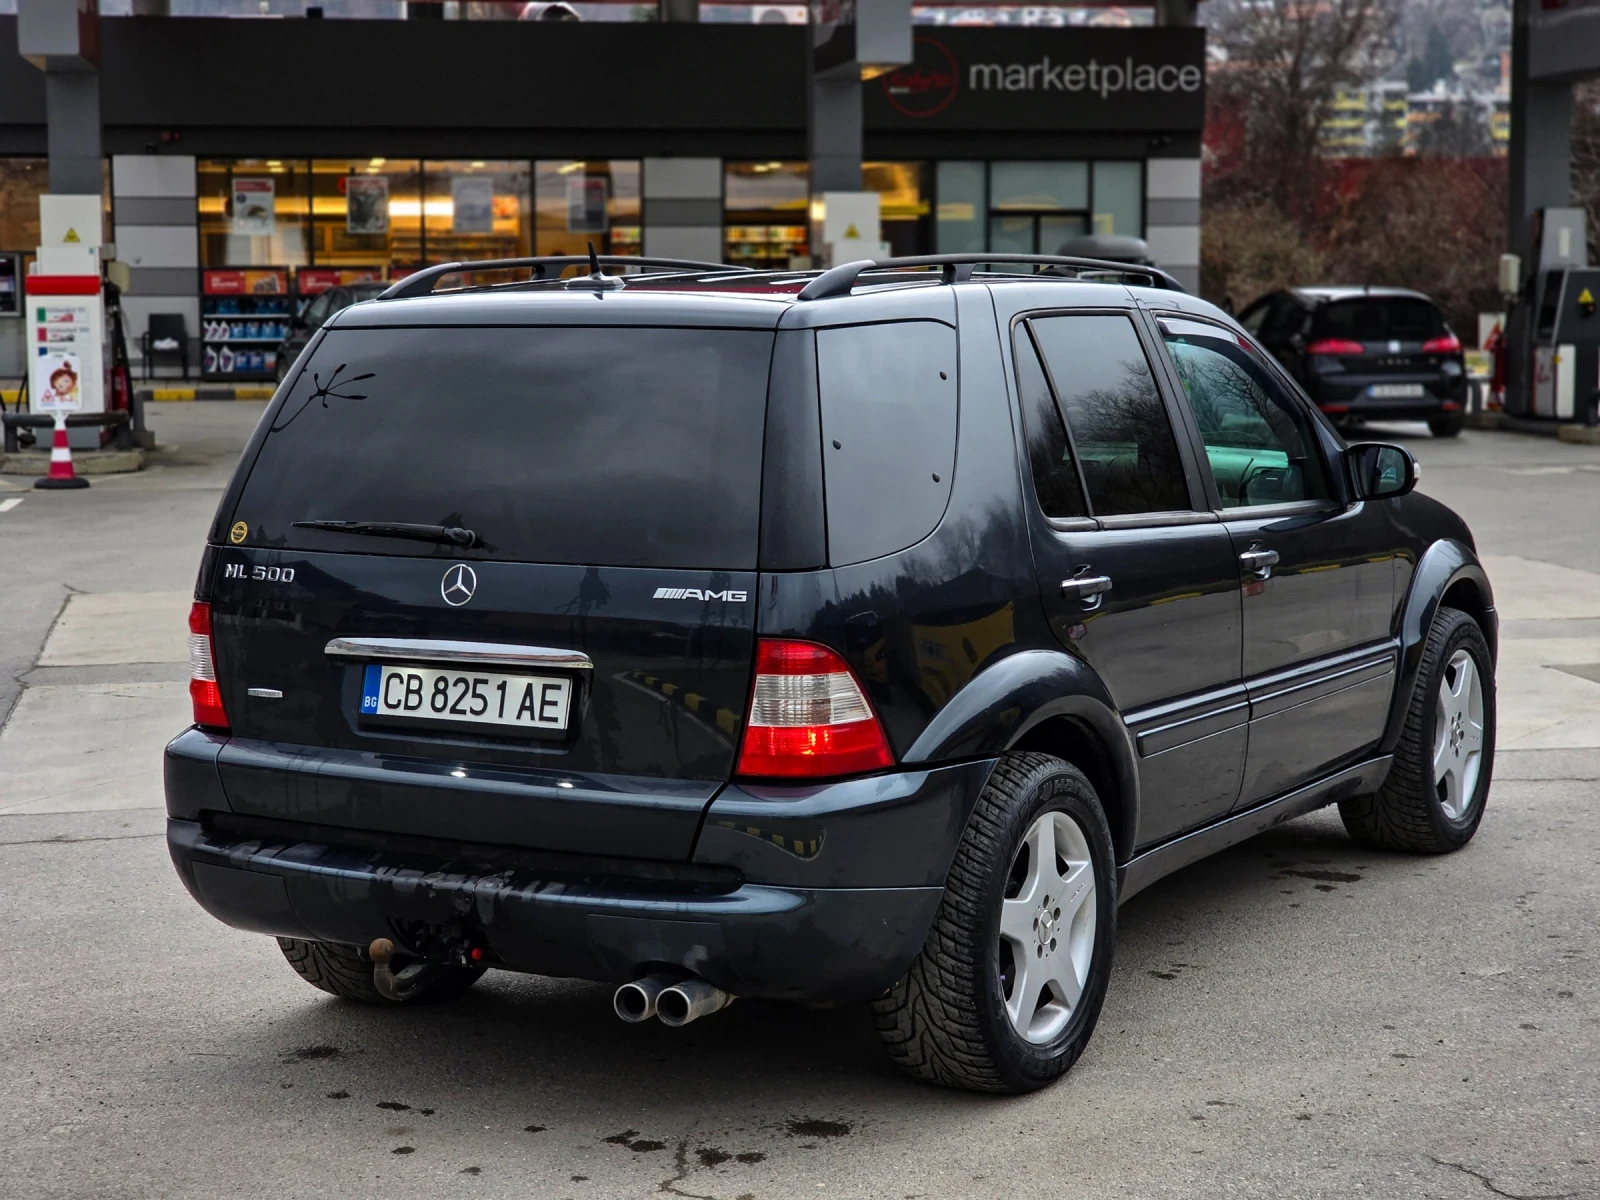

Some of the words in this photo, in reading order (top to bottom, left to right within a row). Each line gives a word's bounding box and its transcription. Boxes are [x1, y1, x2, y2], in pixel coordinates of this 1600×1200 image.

[968, 55, 1201, 99] marketplace
[224, 563, 248, 579] ML
[252, 565, 295, 583] 500
[681, 588, 748, 602] AMG
[364, 695, 377, 708] BG
[384, 672, 424, 711] CB
[430, 675, 508, 719] 8251
[516, 682, 562, 723] AE
